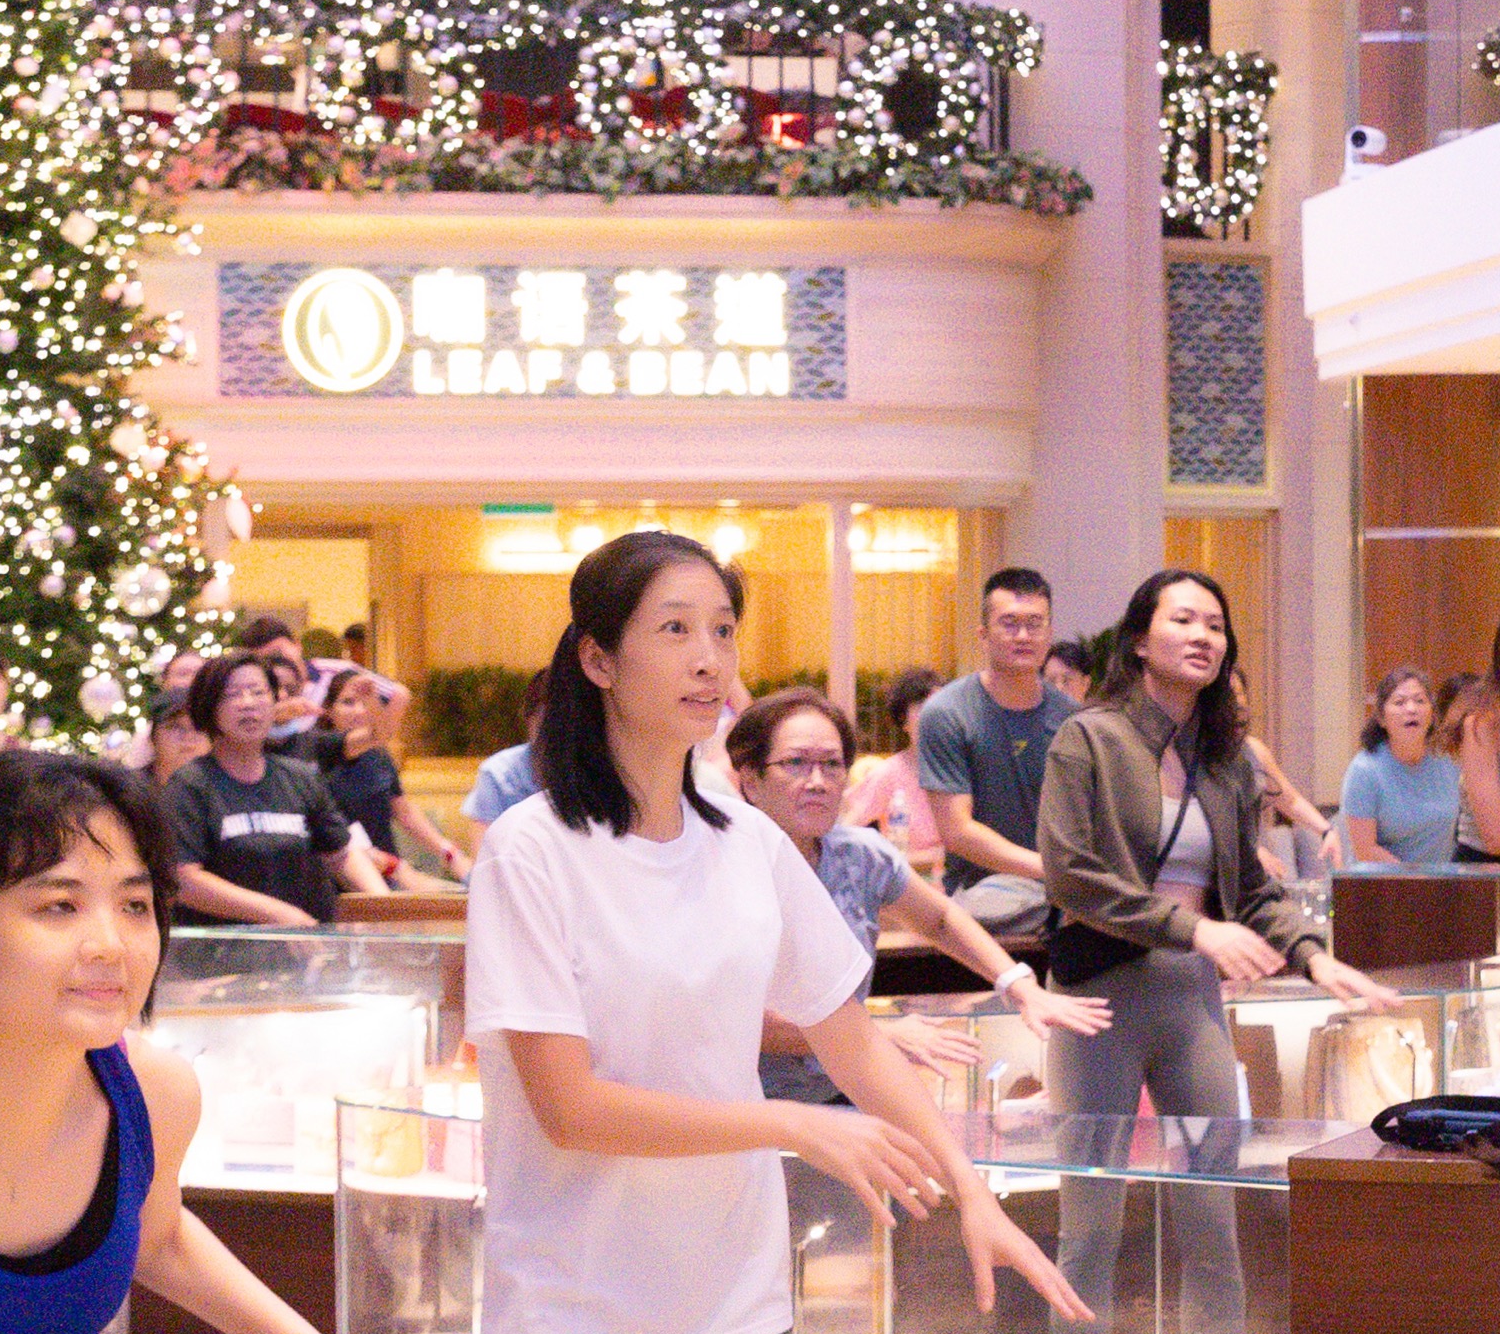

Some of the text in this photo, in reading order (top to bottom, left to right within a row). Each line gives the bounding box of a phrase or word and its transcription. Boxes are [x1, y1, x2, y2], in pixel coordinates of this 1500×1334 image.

[412, 349, 790, 396] LEAF & BEAN
